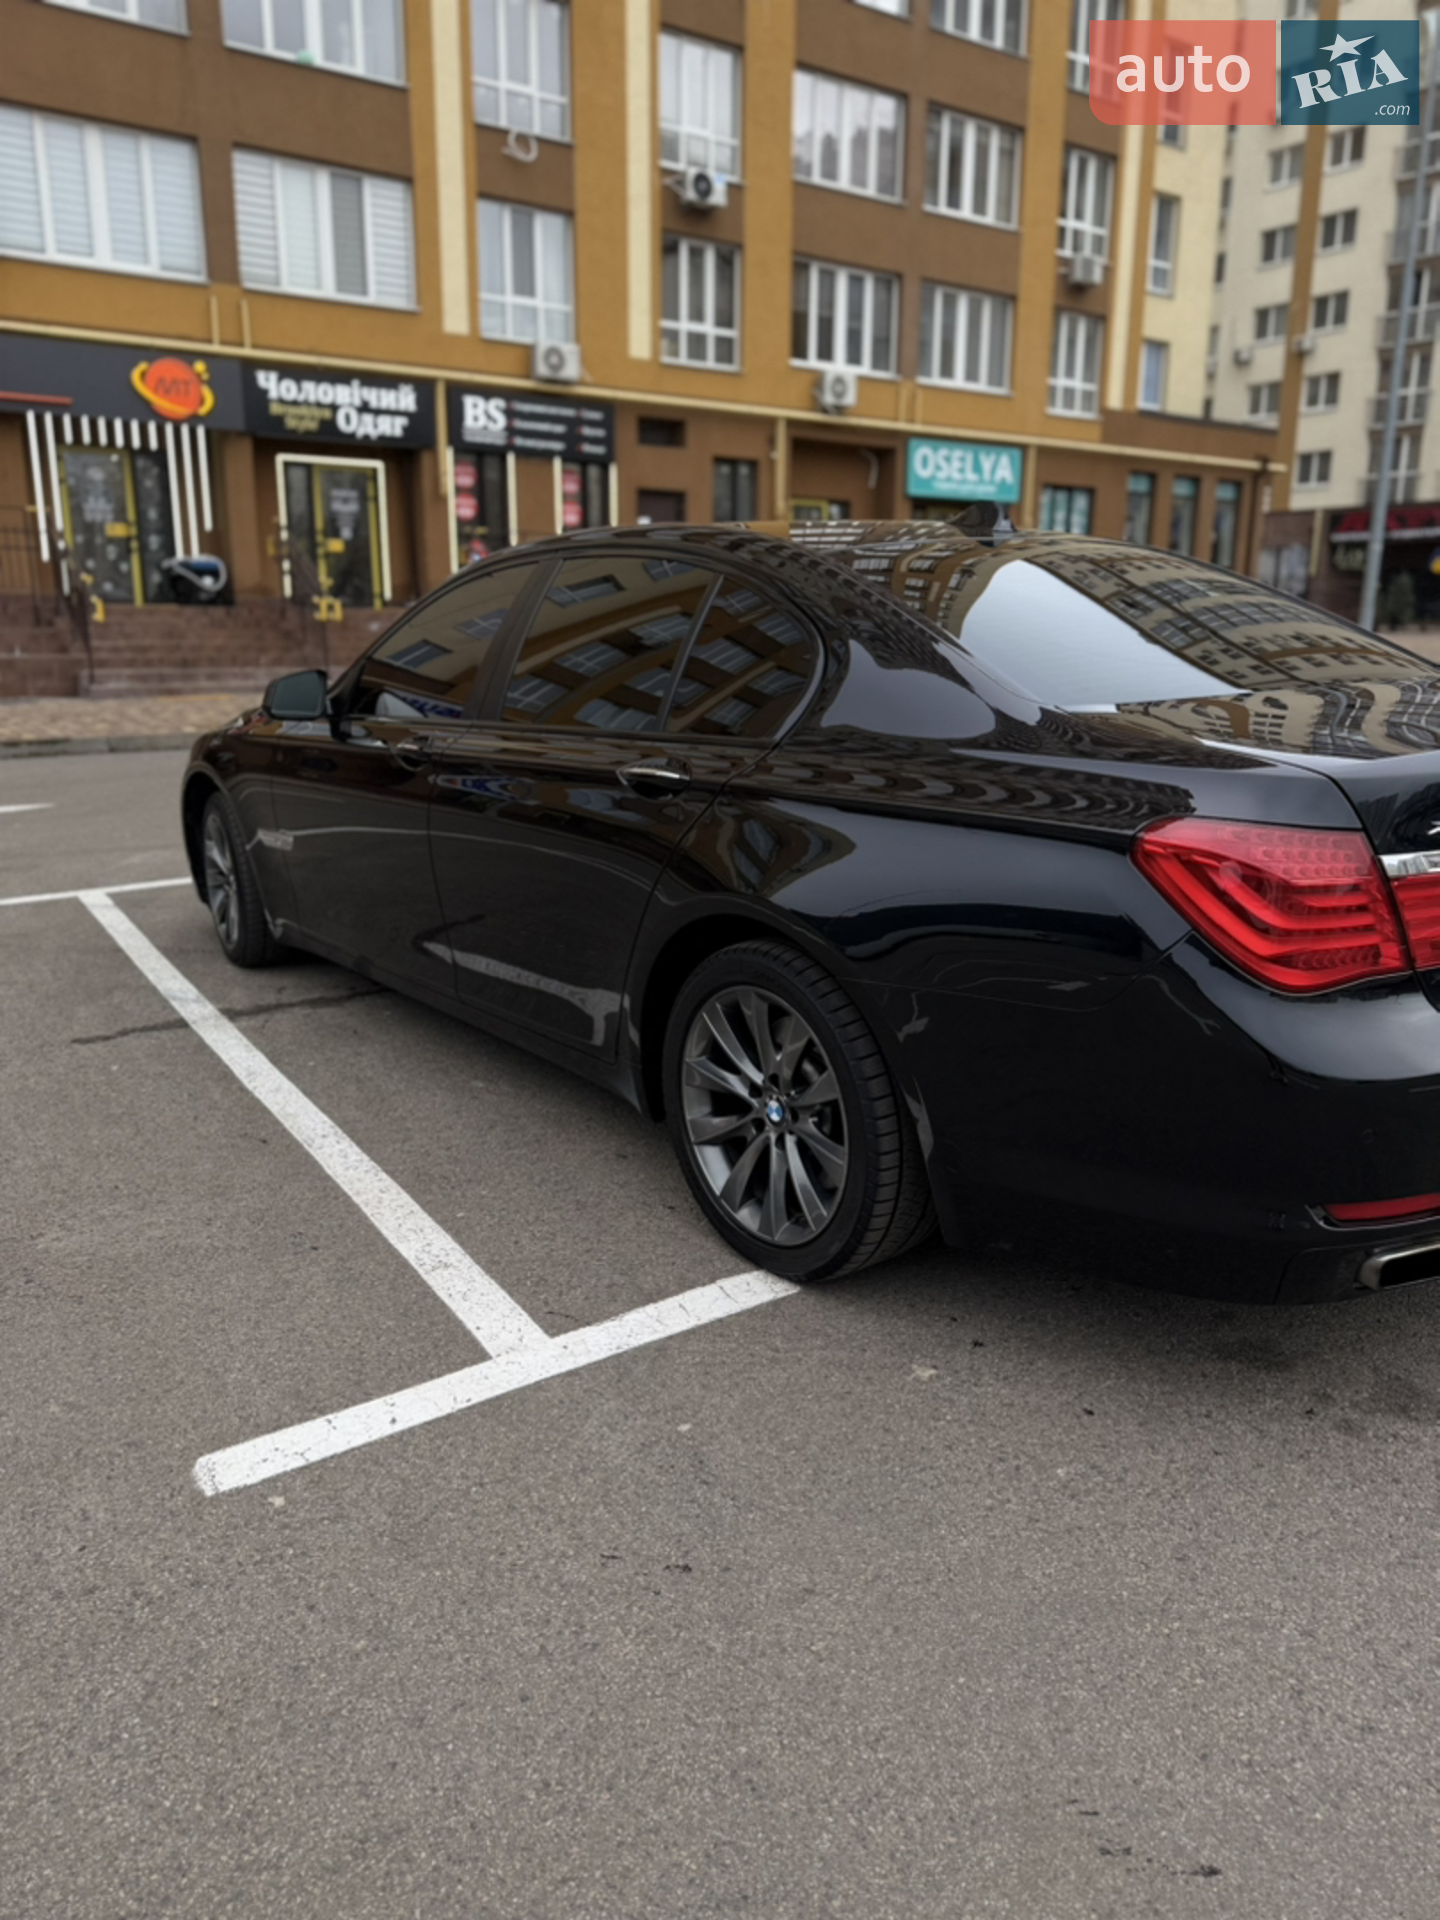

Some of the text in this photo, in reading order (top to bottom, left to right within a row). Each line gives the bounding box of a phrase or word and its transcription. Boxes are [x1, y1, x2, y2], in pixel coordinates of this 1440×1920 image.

[255, 369, 418, 413] Чоловічий
[336, 405, 409, 441] Одяг
[462, 394, 508, 432] BS
[914, 445, 1015, 486] OSELYA
